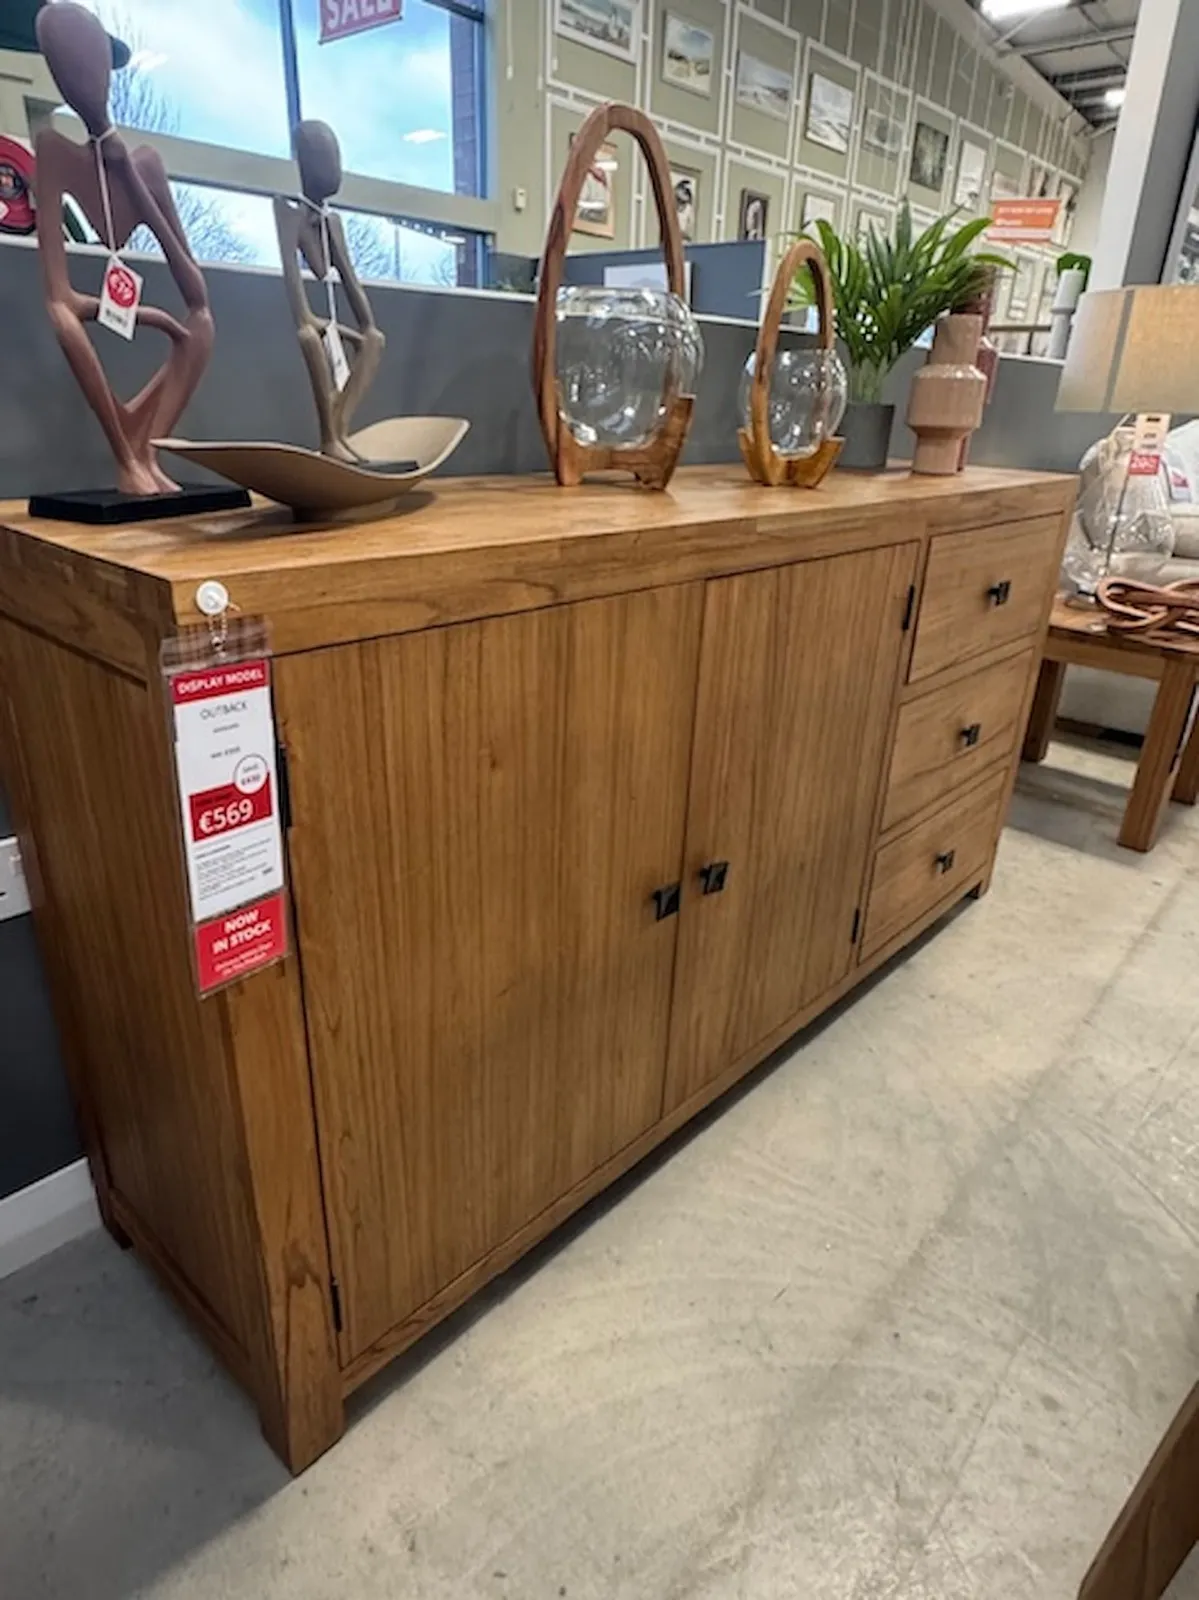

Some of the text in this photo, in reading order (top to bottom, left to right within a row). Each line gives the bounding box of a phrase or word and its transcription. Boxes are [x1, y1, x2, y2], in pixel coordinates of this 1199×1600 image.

[177, 668, 264, 694] DISPLAY MODEL
[200, 700, 248, 720] OUTBACK
[199, 798, 254, 834] €569
[224, 909, 260, 934] NOW
[212, 919, 272, 954] IN STOCK
